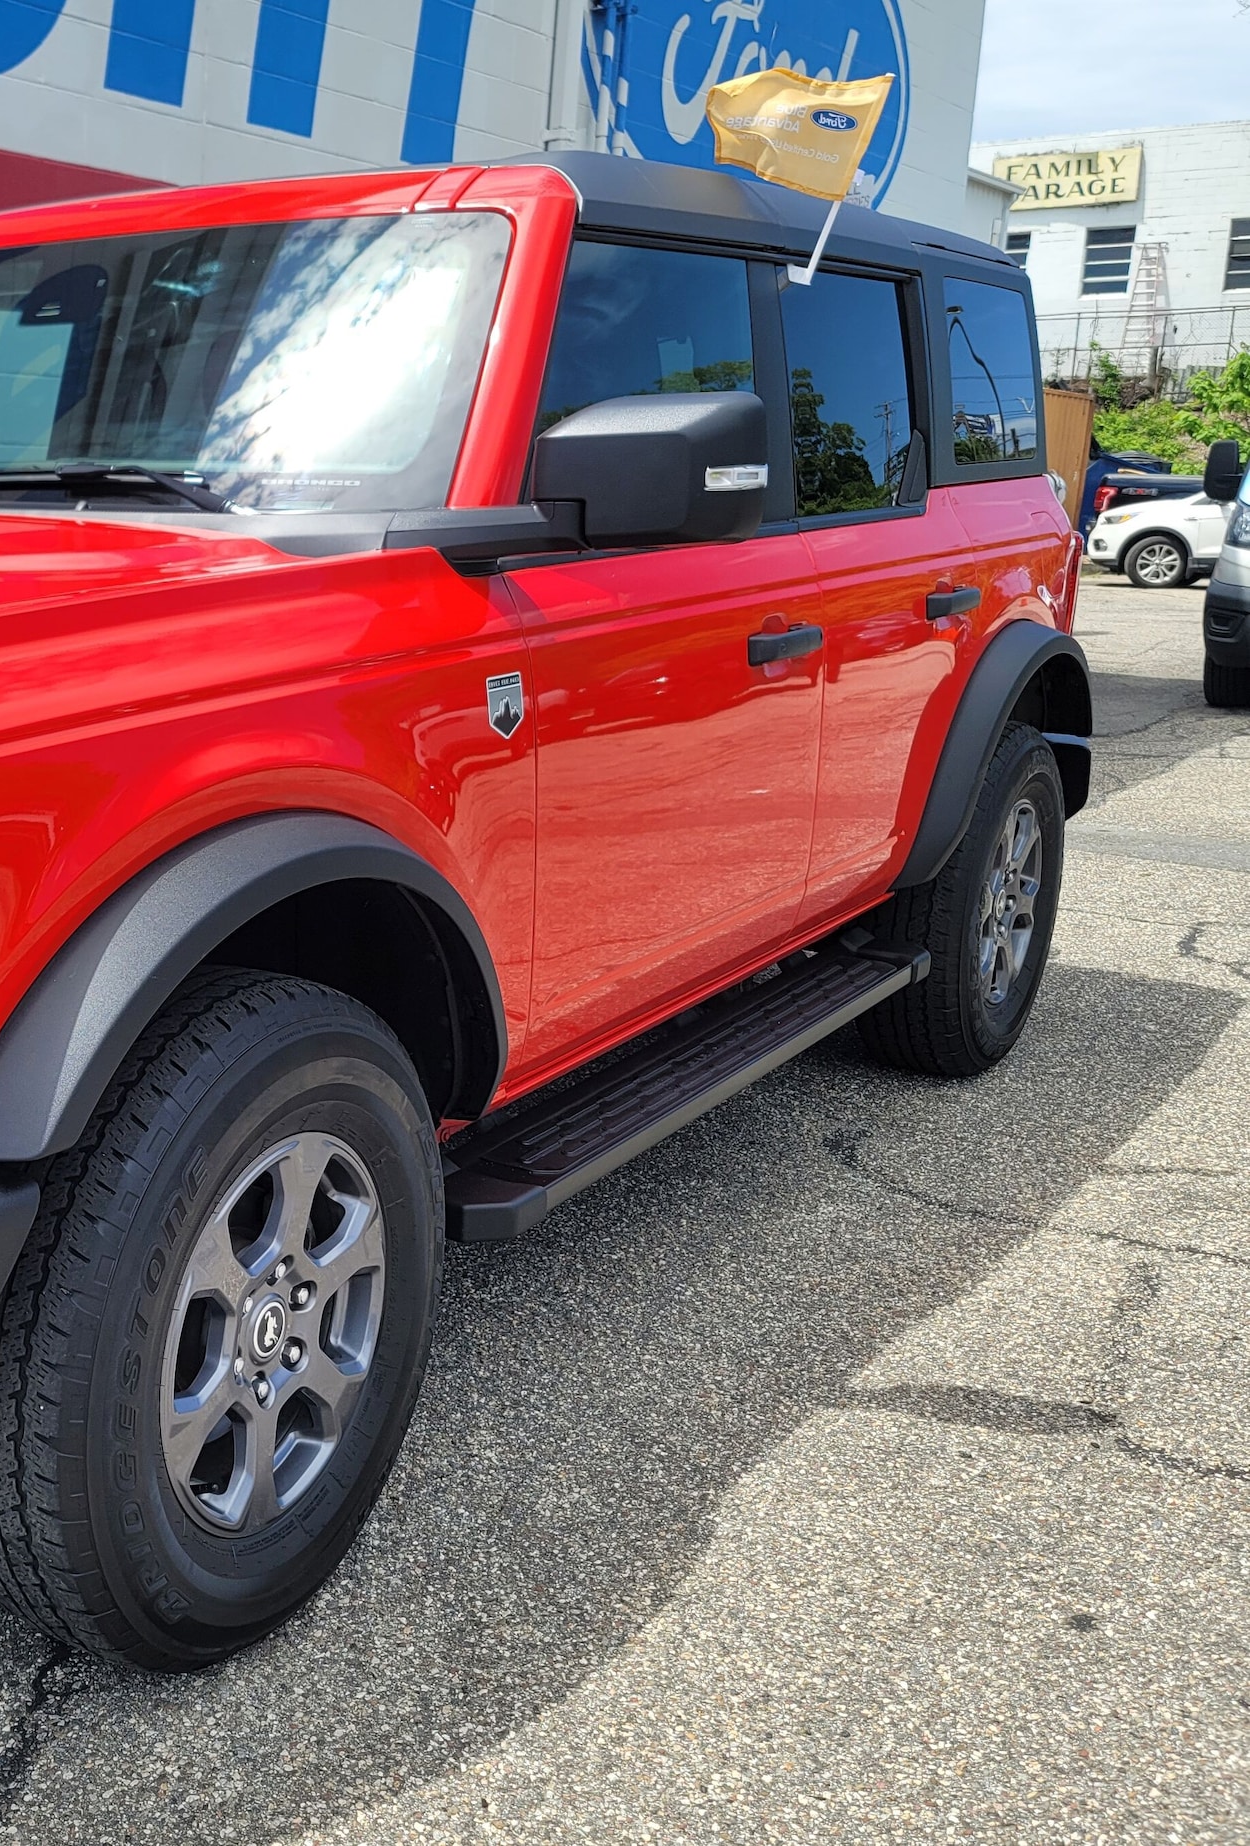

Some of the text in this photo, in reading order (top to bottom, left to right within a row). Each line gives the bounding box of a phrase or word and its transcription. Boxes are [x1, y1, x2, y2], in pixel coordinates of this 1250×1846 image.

[1006, 155, 1127, 182] FAMILY
[1022, 177, 1126, 202] ARAGE
[108, 1146, 209, 1627] BRIDGESTONE
